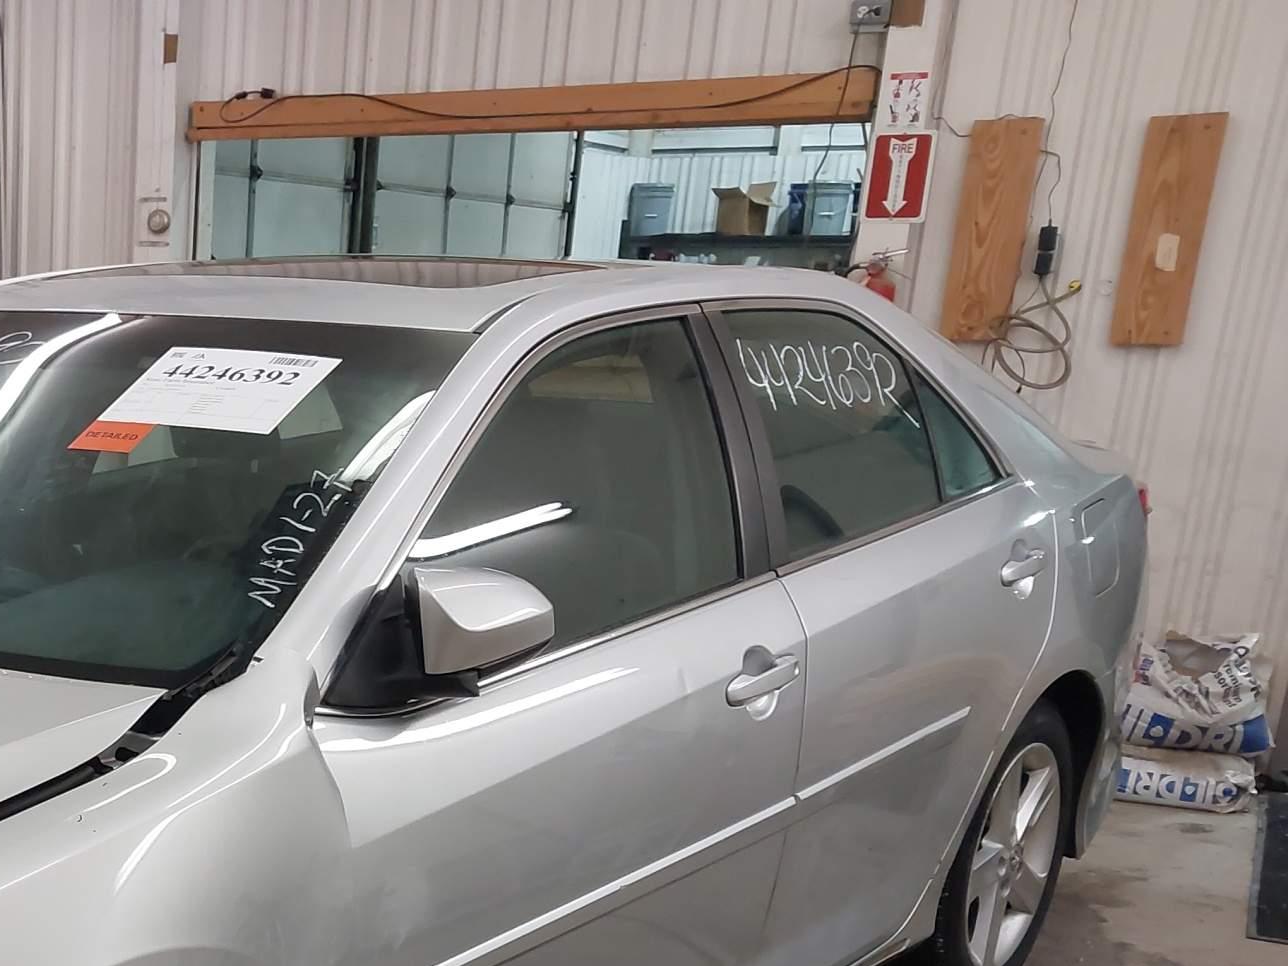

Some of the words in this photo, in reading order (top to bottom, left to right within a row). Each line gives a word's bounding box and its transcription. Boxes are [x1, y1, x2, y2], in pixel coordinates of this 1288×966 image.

[892, 143, 914, 154] FIRE
[162, 364, 301, 386] 44246392
[85, 431, 139, 441] DETAILED
